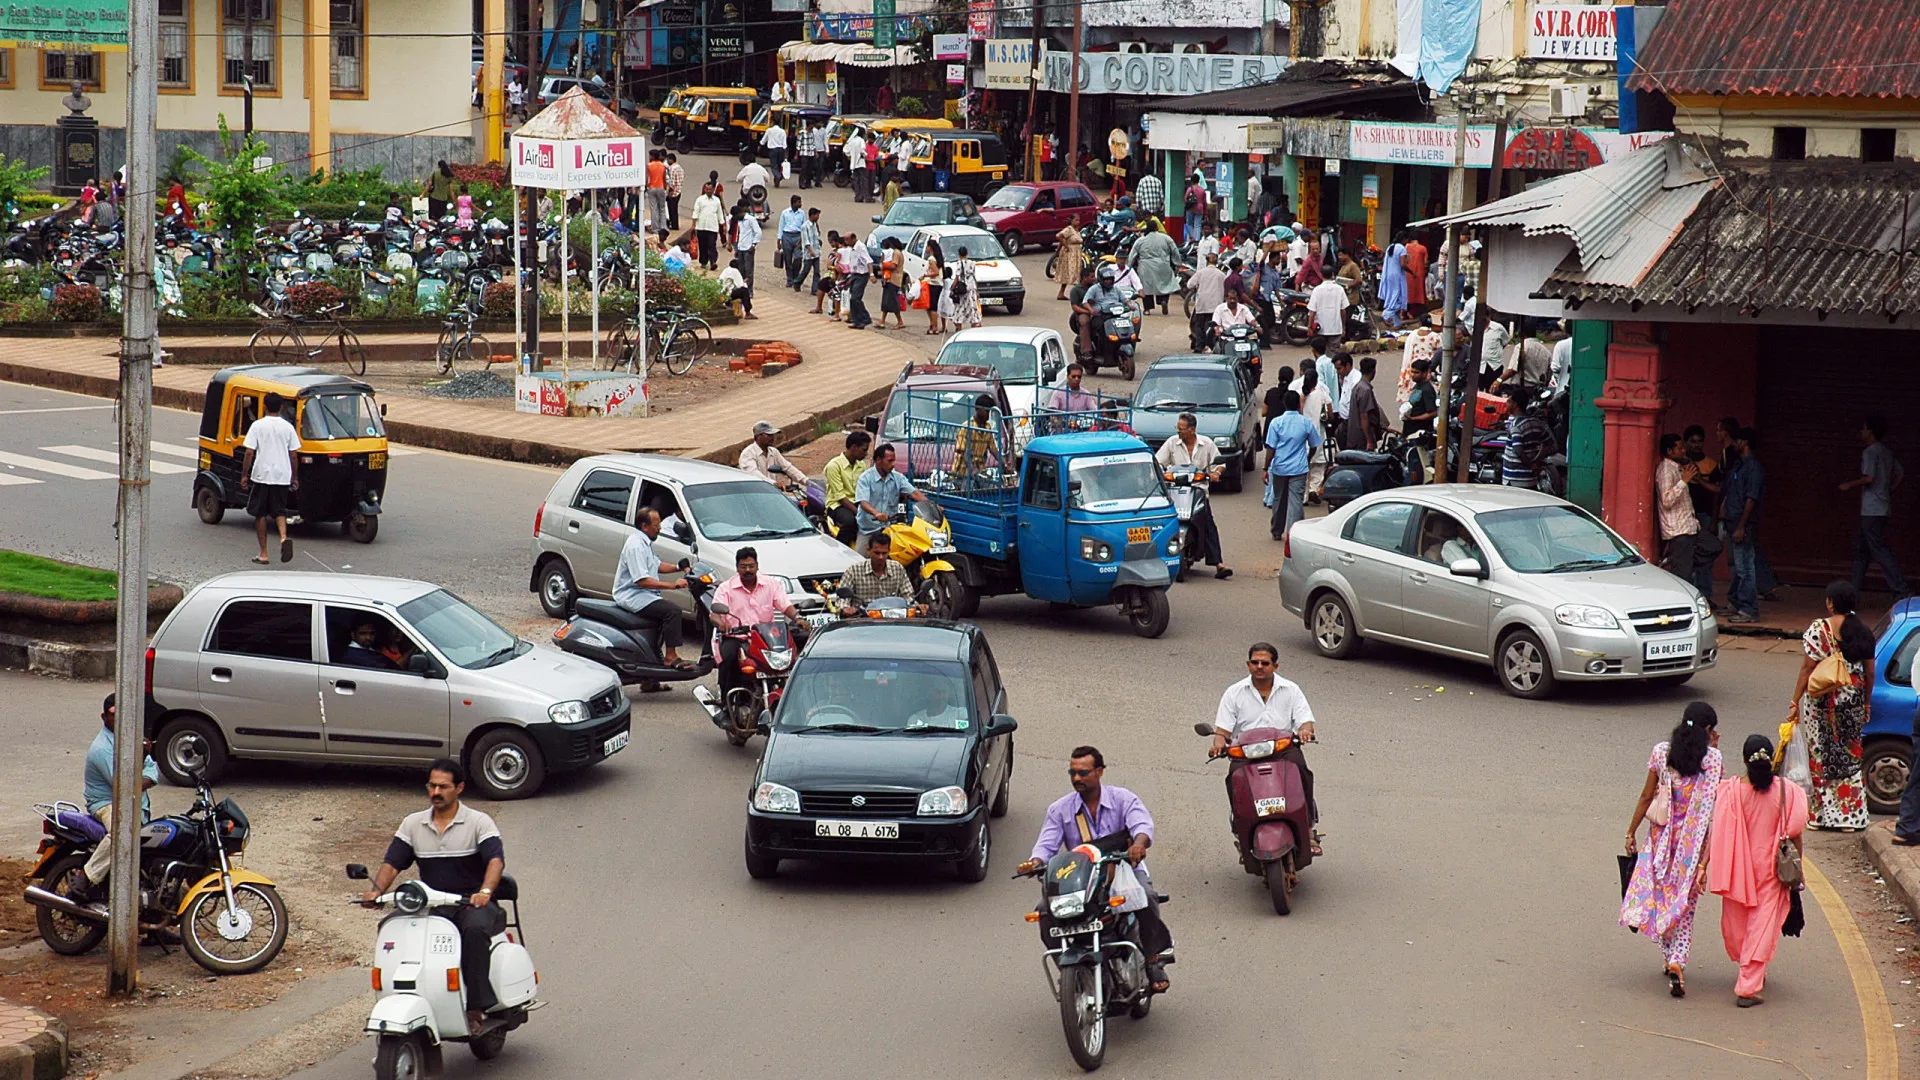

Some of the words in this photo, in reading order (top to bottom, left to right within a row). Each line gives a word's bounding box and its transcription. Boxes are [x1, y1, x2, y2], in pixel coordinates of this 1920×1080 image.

[9, 5, 29, 17] Goa
[33, 6, 62, 18] State
[66, 7, 96, 23] Co-op
[100, 8, 125, 21] Bank
[710, 38, 740, 46] VENICE
[1103, 56, 1266, 92] CORNER
[1370, 127, 1406, 144] SHANKAR
[1446, 132, 1452, 147] &
[1454, 132, 1481, 149] SNS
[525, 149, 551, 168] Airtel
[585, 149, 629, 167] Airtel
[1389, 148, 1445, 160] JEWELLERS
[1512, 149, 1590, 169] CORNER
[514, 169, 534, 180] Express
[567, 172, 601, 184] Express
[603, 168, 640, 180] Yourself
[1221, 164, 1228, 180] P
[545, 392, 560, 403] GOA
[541, 404, 564, 416] POLICE
[1650, 646, 1660, 655] GA
[1672, 644, 1677, 653] E
[1260, 798, 1280, 806] GA02
[817, 824, 831, 836] GA
[838, 824, 851, 836] 08
[861, 826, 868, 837] A
[875, 826, 897, 837] 6176
